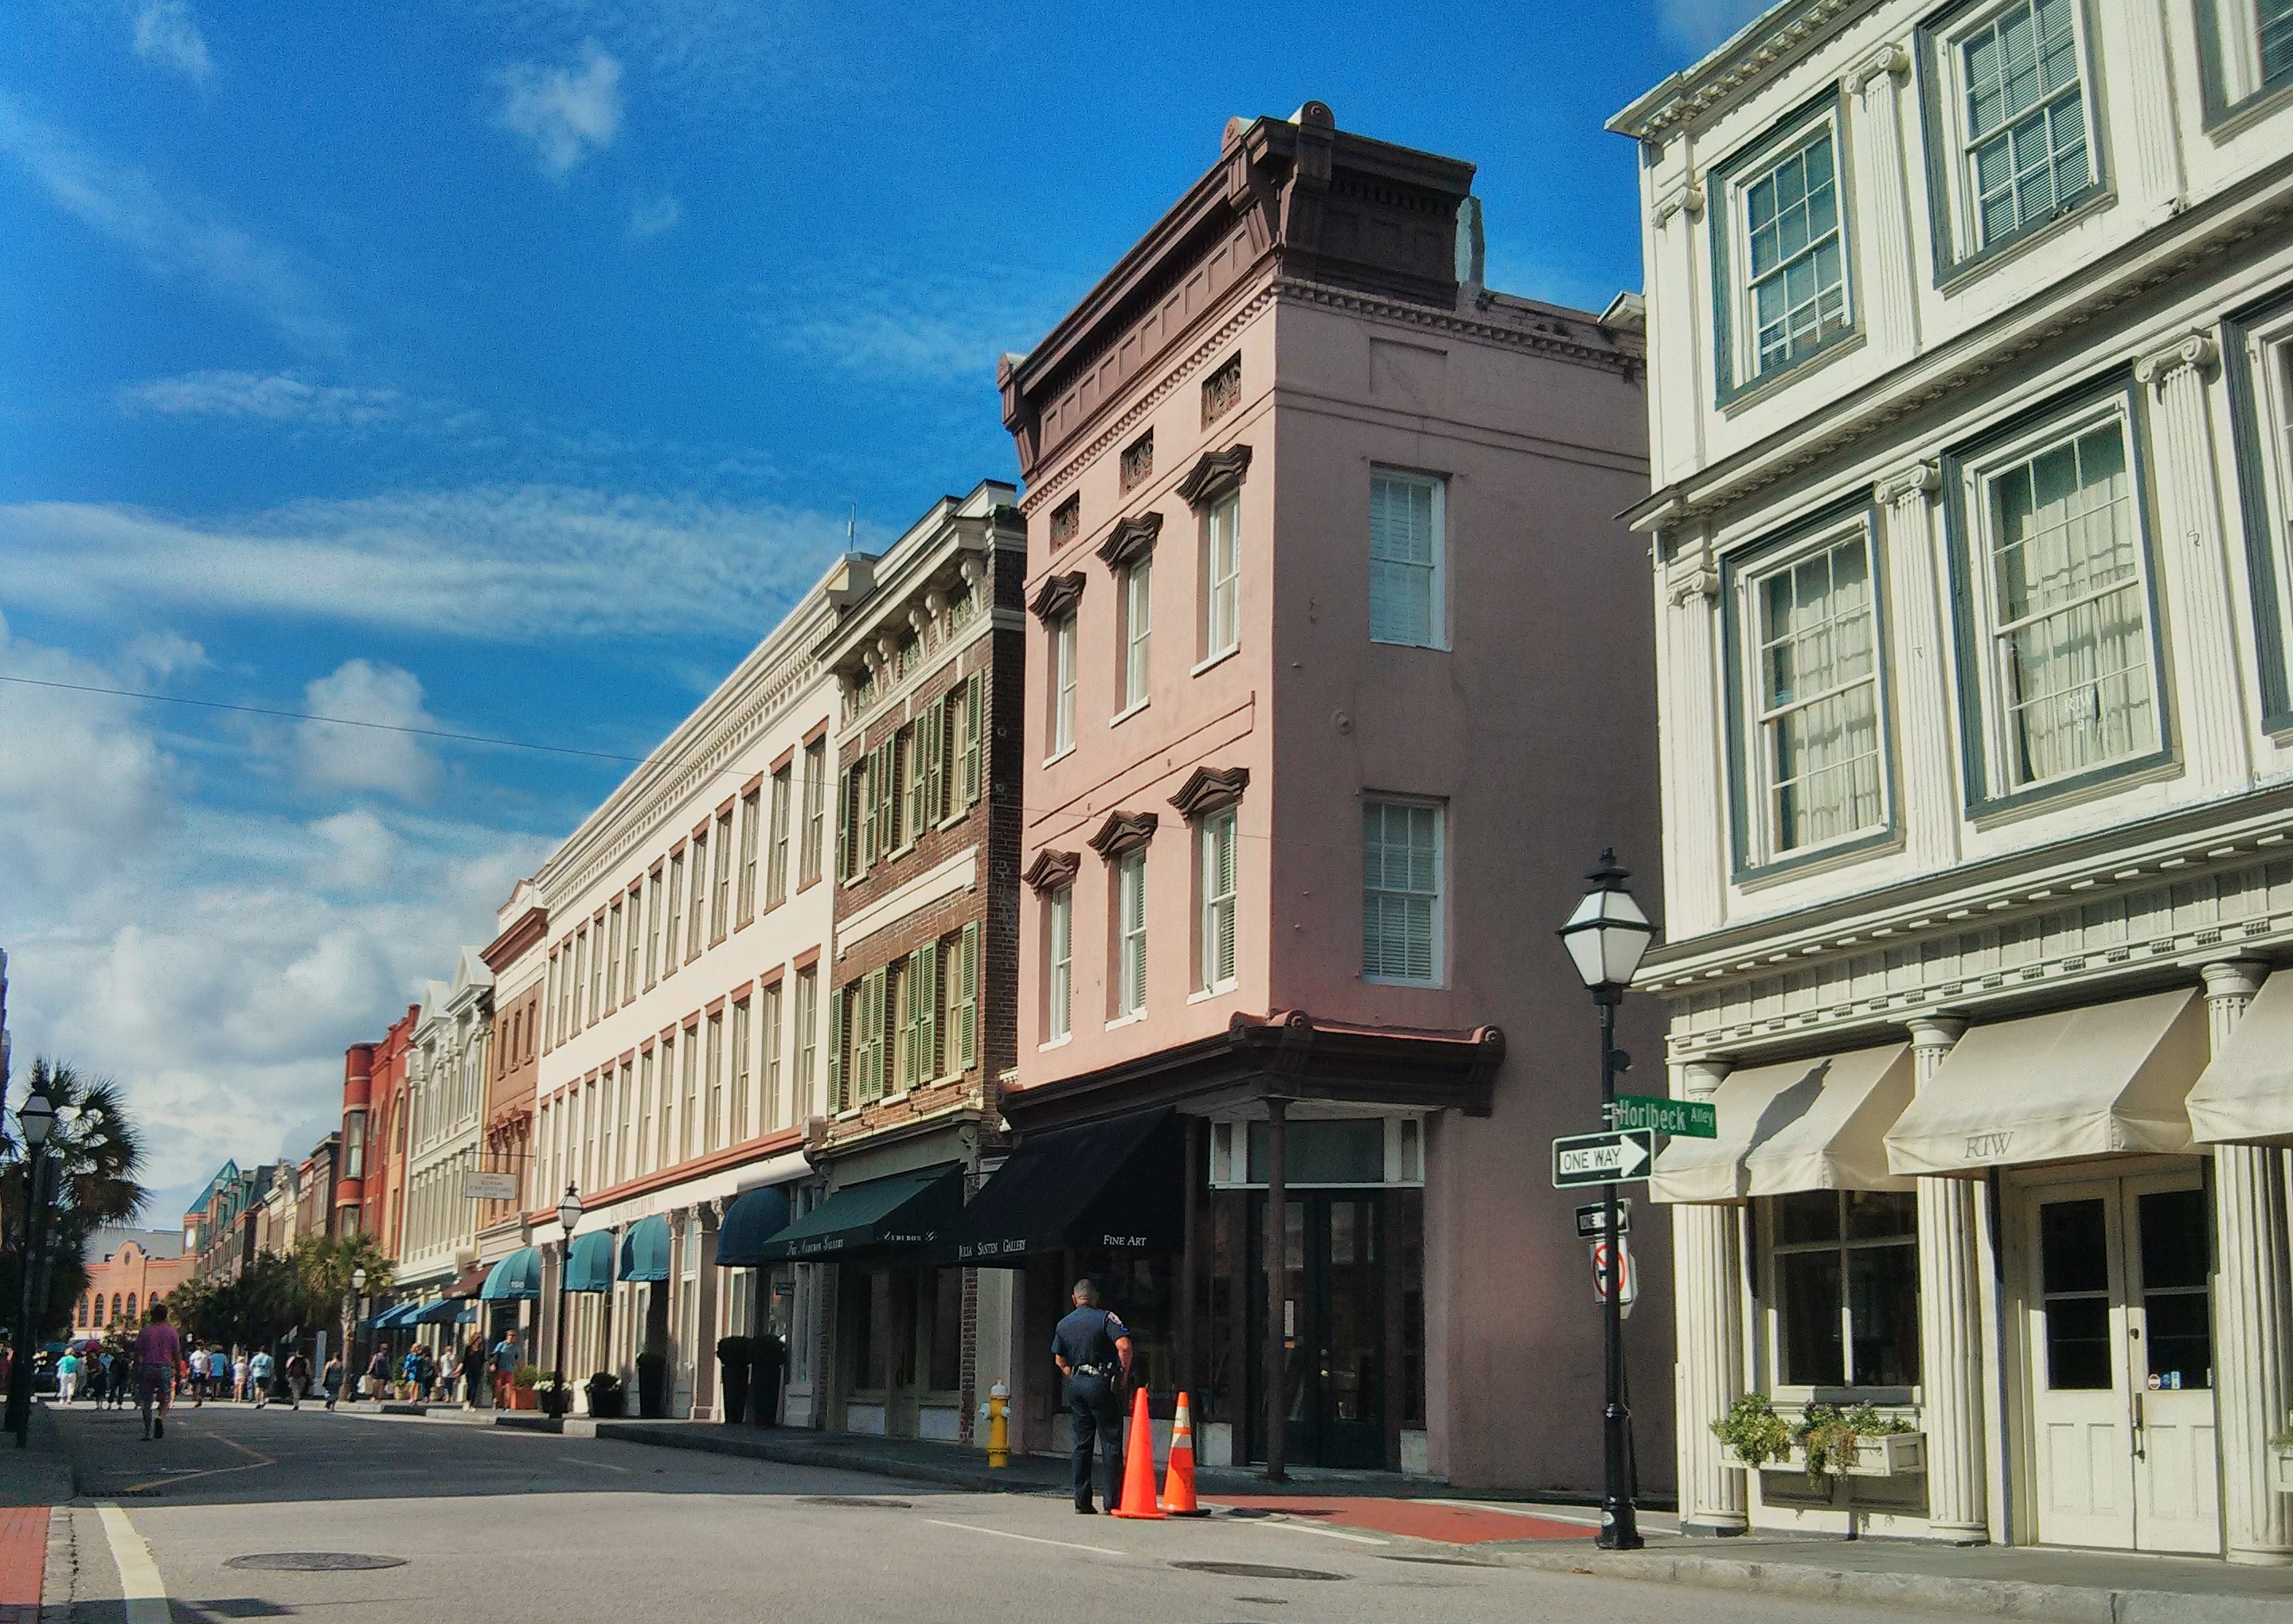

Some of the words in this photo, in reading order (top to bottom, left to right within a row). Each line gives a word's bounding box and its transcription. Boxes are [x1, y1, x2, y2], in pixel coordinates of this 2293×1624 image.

[1619, 1099, 1686, 1131] Horlbeck
[1690, 1107, 1714, 1128] Alley
[1964, 1130, 2014, 1159] RTW
[1564, 1151, 1589, 1171] ONE
[1593, 1147, 1621, 1167] WAY
[1581, 1215, 1596, 1228] ONE
[958, 1244, 972, 1261] JULIA
[977, 1241, 998, 1256] SANTEN
[1002, 1238, 1027, 1253] GALLERY
[1103, 1234, 1126, 1246] FINE
[1127, 1235, 1147, 1247] ART
